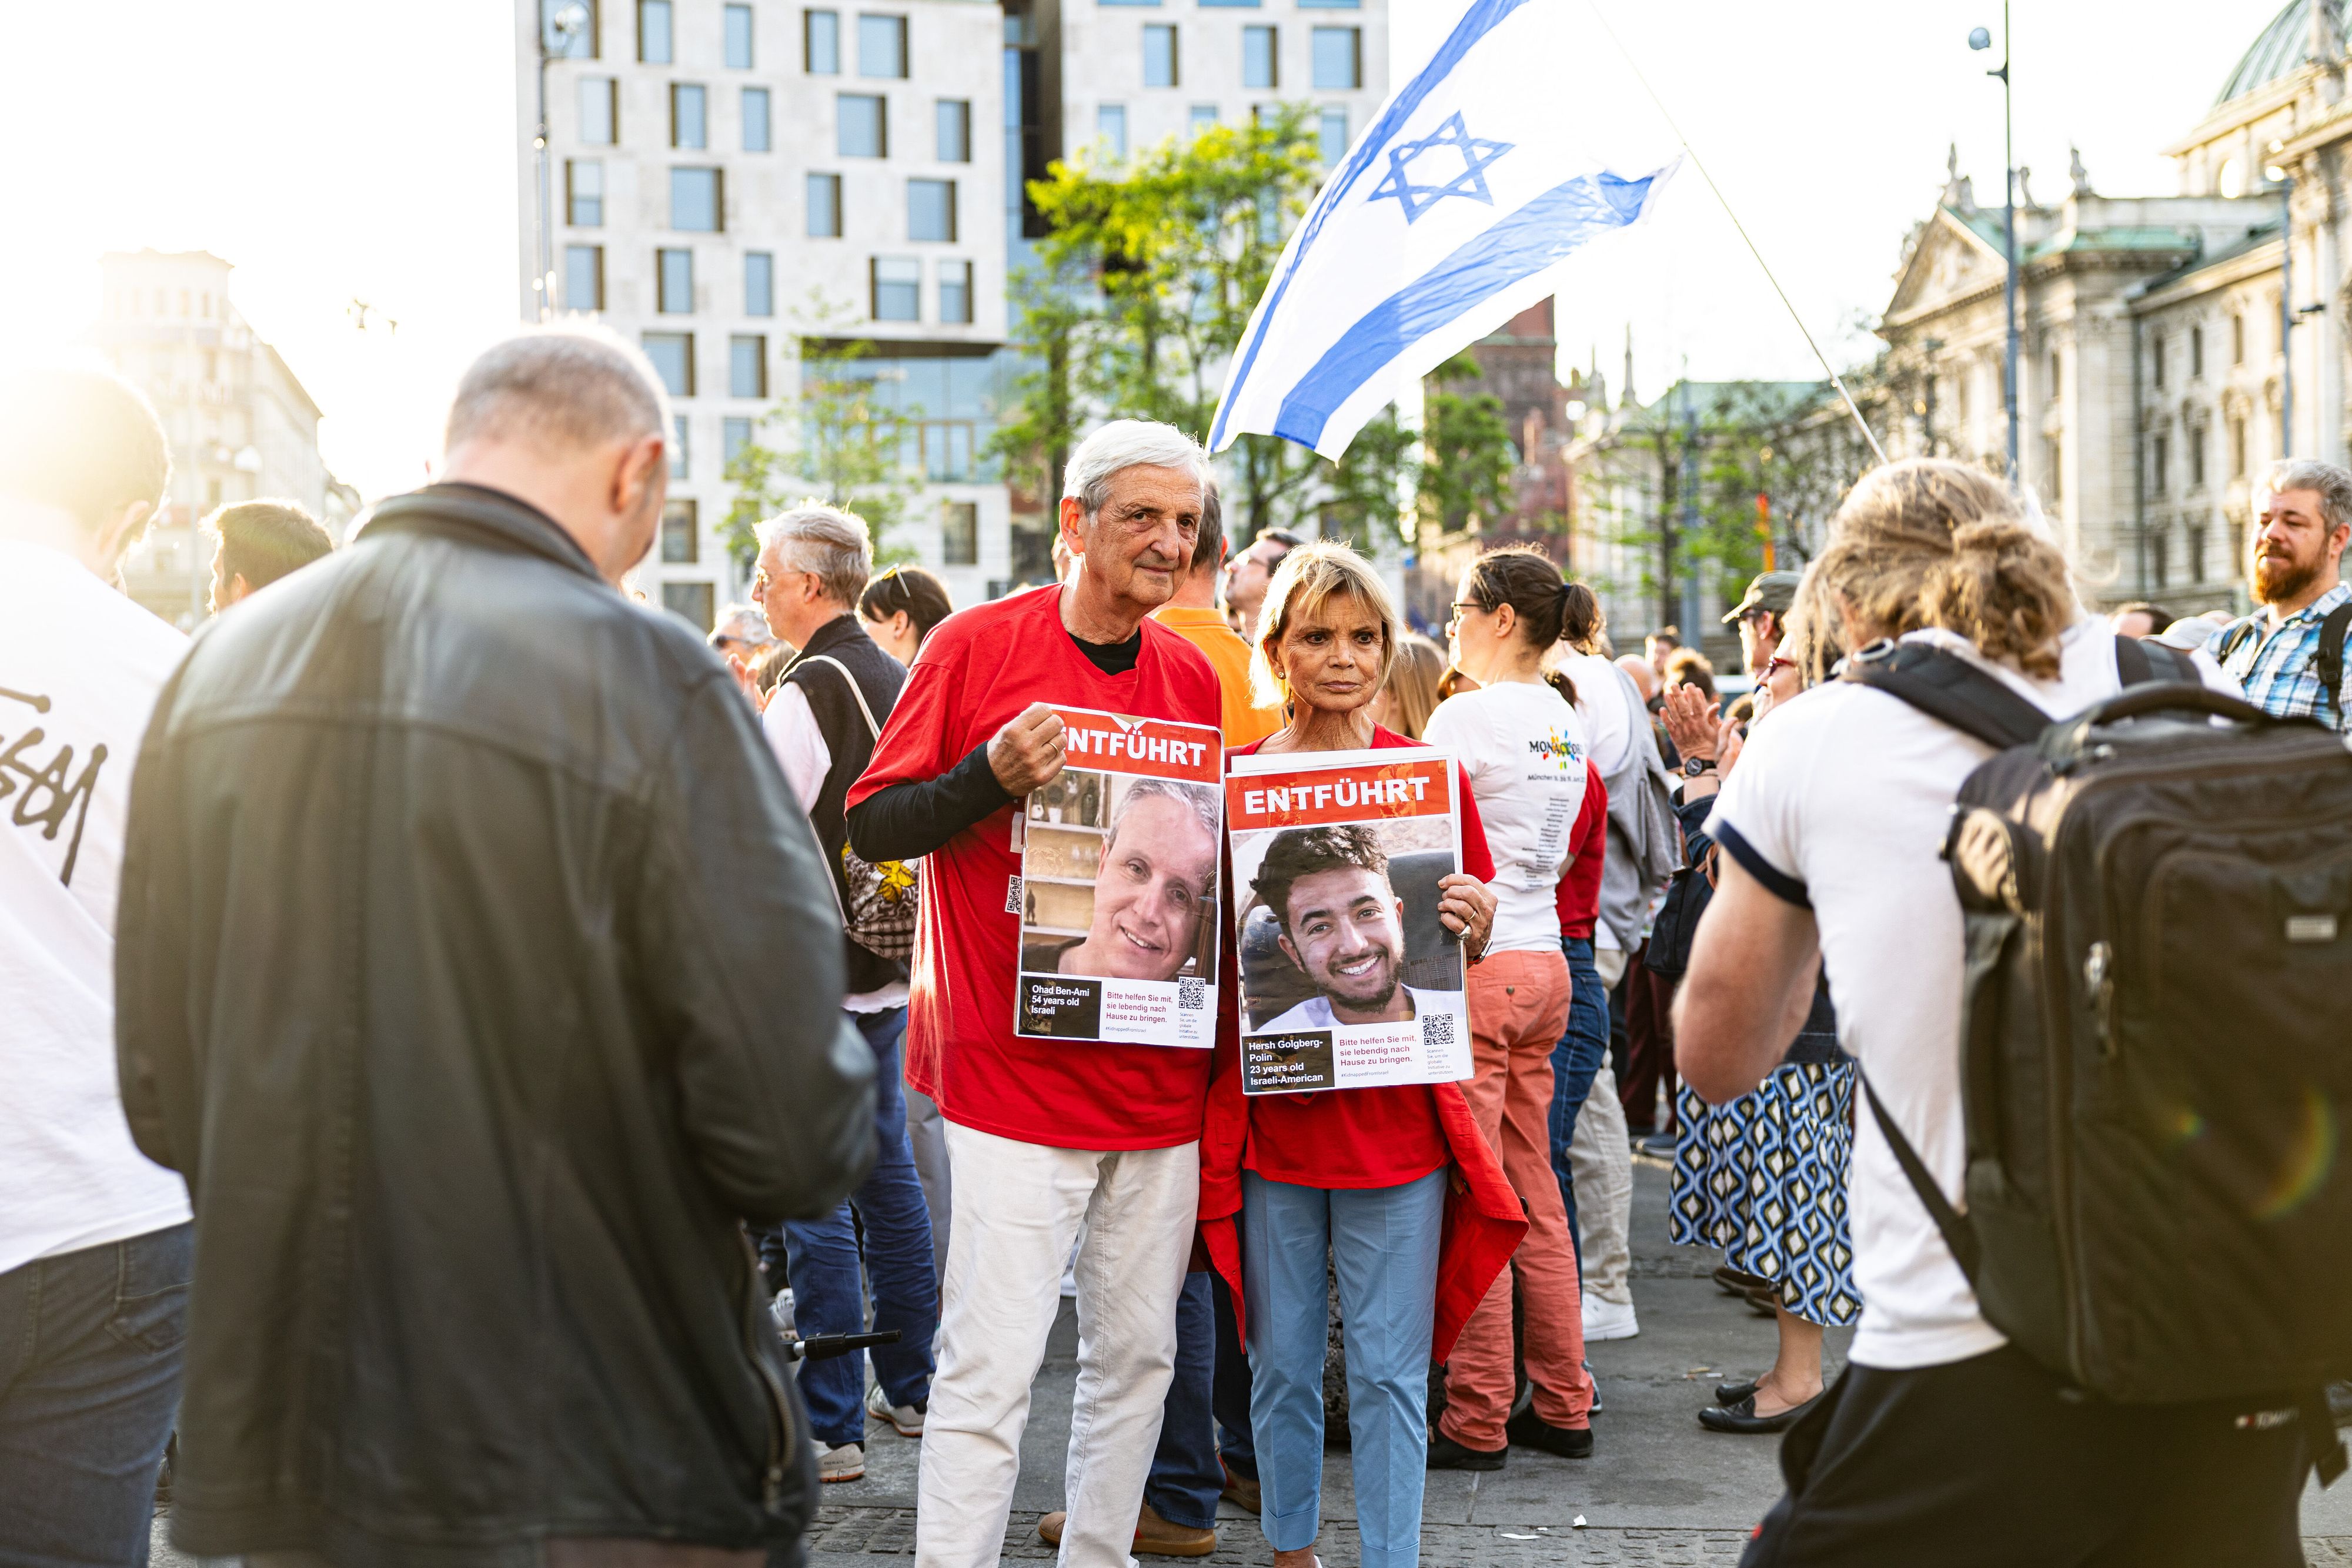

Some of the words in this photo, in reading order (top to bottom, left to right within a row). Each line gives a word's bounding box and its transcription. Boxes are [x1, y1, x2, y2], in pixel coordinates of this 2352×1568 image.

[1244, 776, 1430, 814] ENTFÜHRT
[1032, 984, 1054, 994] Ohad
[1055, 986, 1090, 997] Ben-Ami
[1032, 995, 1041, 1004] 54
[1043, 997, 1065, 1006] years
[1067, 997, 1080, 1006] old
[1107, 991, 1123, 999] Bitte
[1161, 995, 1173, 1004] mit,
[1031, 1005, 1055, 1015] Israeli
[1118, 1002, 1148, 1013] lebendig
[1106, 1012, 1128, 1020] Hause
[1140, 1014, 1167, 1024] bringen.
[1248, 1041, 1275, 1051] Hersh
[1277, 1039, 1323, 1049] Golgberg-
[1354, 1047, 1388, 1055] lebendig
[1250, 1053, 1272, 1062] Polin
[1379, 1057, 1412, 1065] bringen.
[1250, 1065, 1261, 1074] 23
[1262, 1064, 1288, 1075] years
[1289, 1062, 1304, 1071] old
[1250, 1074, 1324, 1085] Israeli-American
